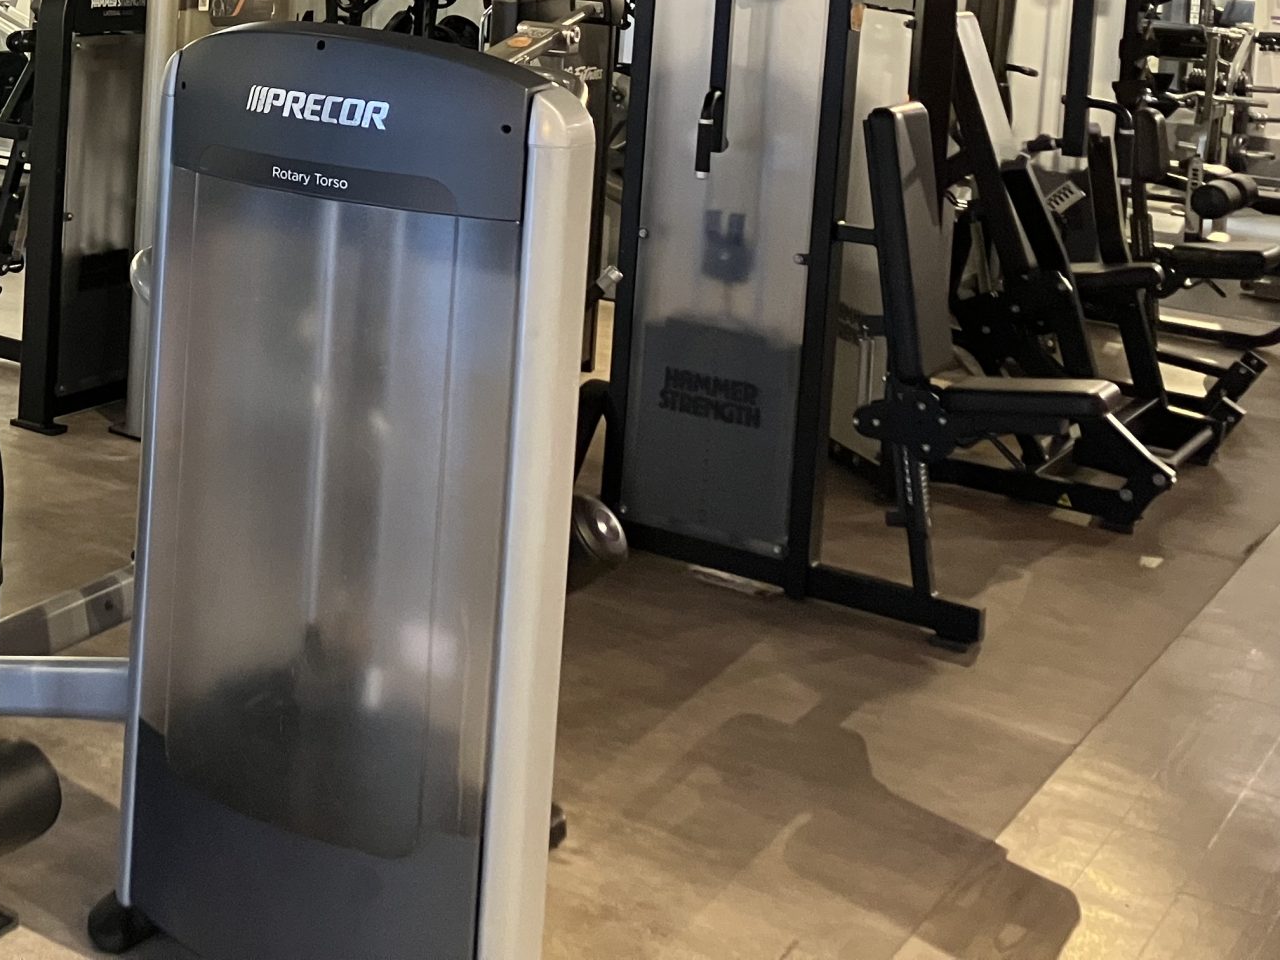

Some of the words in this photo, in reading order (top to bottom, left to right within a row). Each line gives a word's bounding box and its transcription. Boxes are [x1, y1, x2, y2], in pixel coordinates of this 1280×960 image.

[246, 84, 390, 131] PRECOR
[272, 166, 311, 186] Rotary
[314, 172, 349, 190] Torso
[664, 366, 759, 406] HAMMER
[658, 388, 761, 430] STRENGTH
